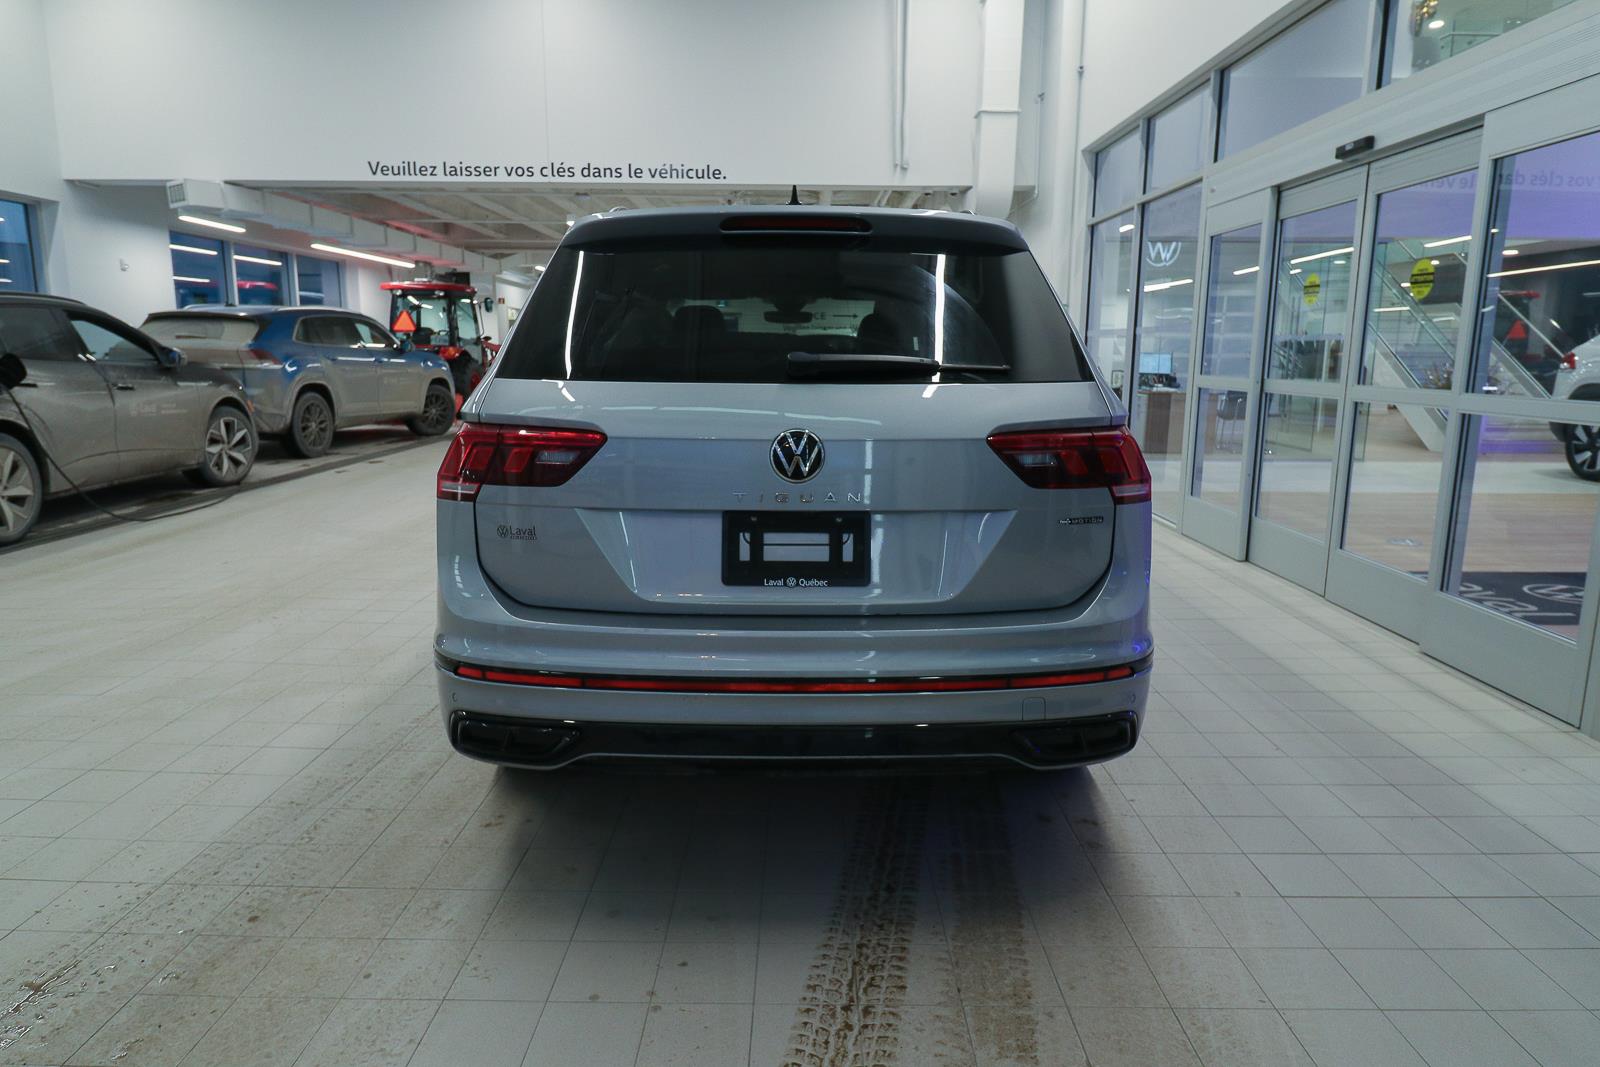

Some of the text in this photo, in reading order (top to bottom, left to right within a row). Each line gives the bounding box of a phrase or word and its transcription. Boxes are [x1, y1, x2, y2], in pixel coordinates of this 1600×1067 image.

[367, 160, 727, 180] Veuillez laisser vos clés dans le véhicule.
[732, 490, 862, 503] TIGUAN
[509, 525, 536, 536] Laval
[763, 578, 784, 586] Laval
[798, 578, 828, 587] Québec
